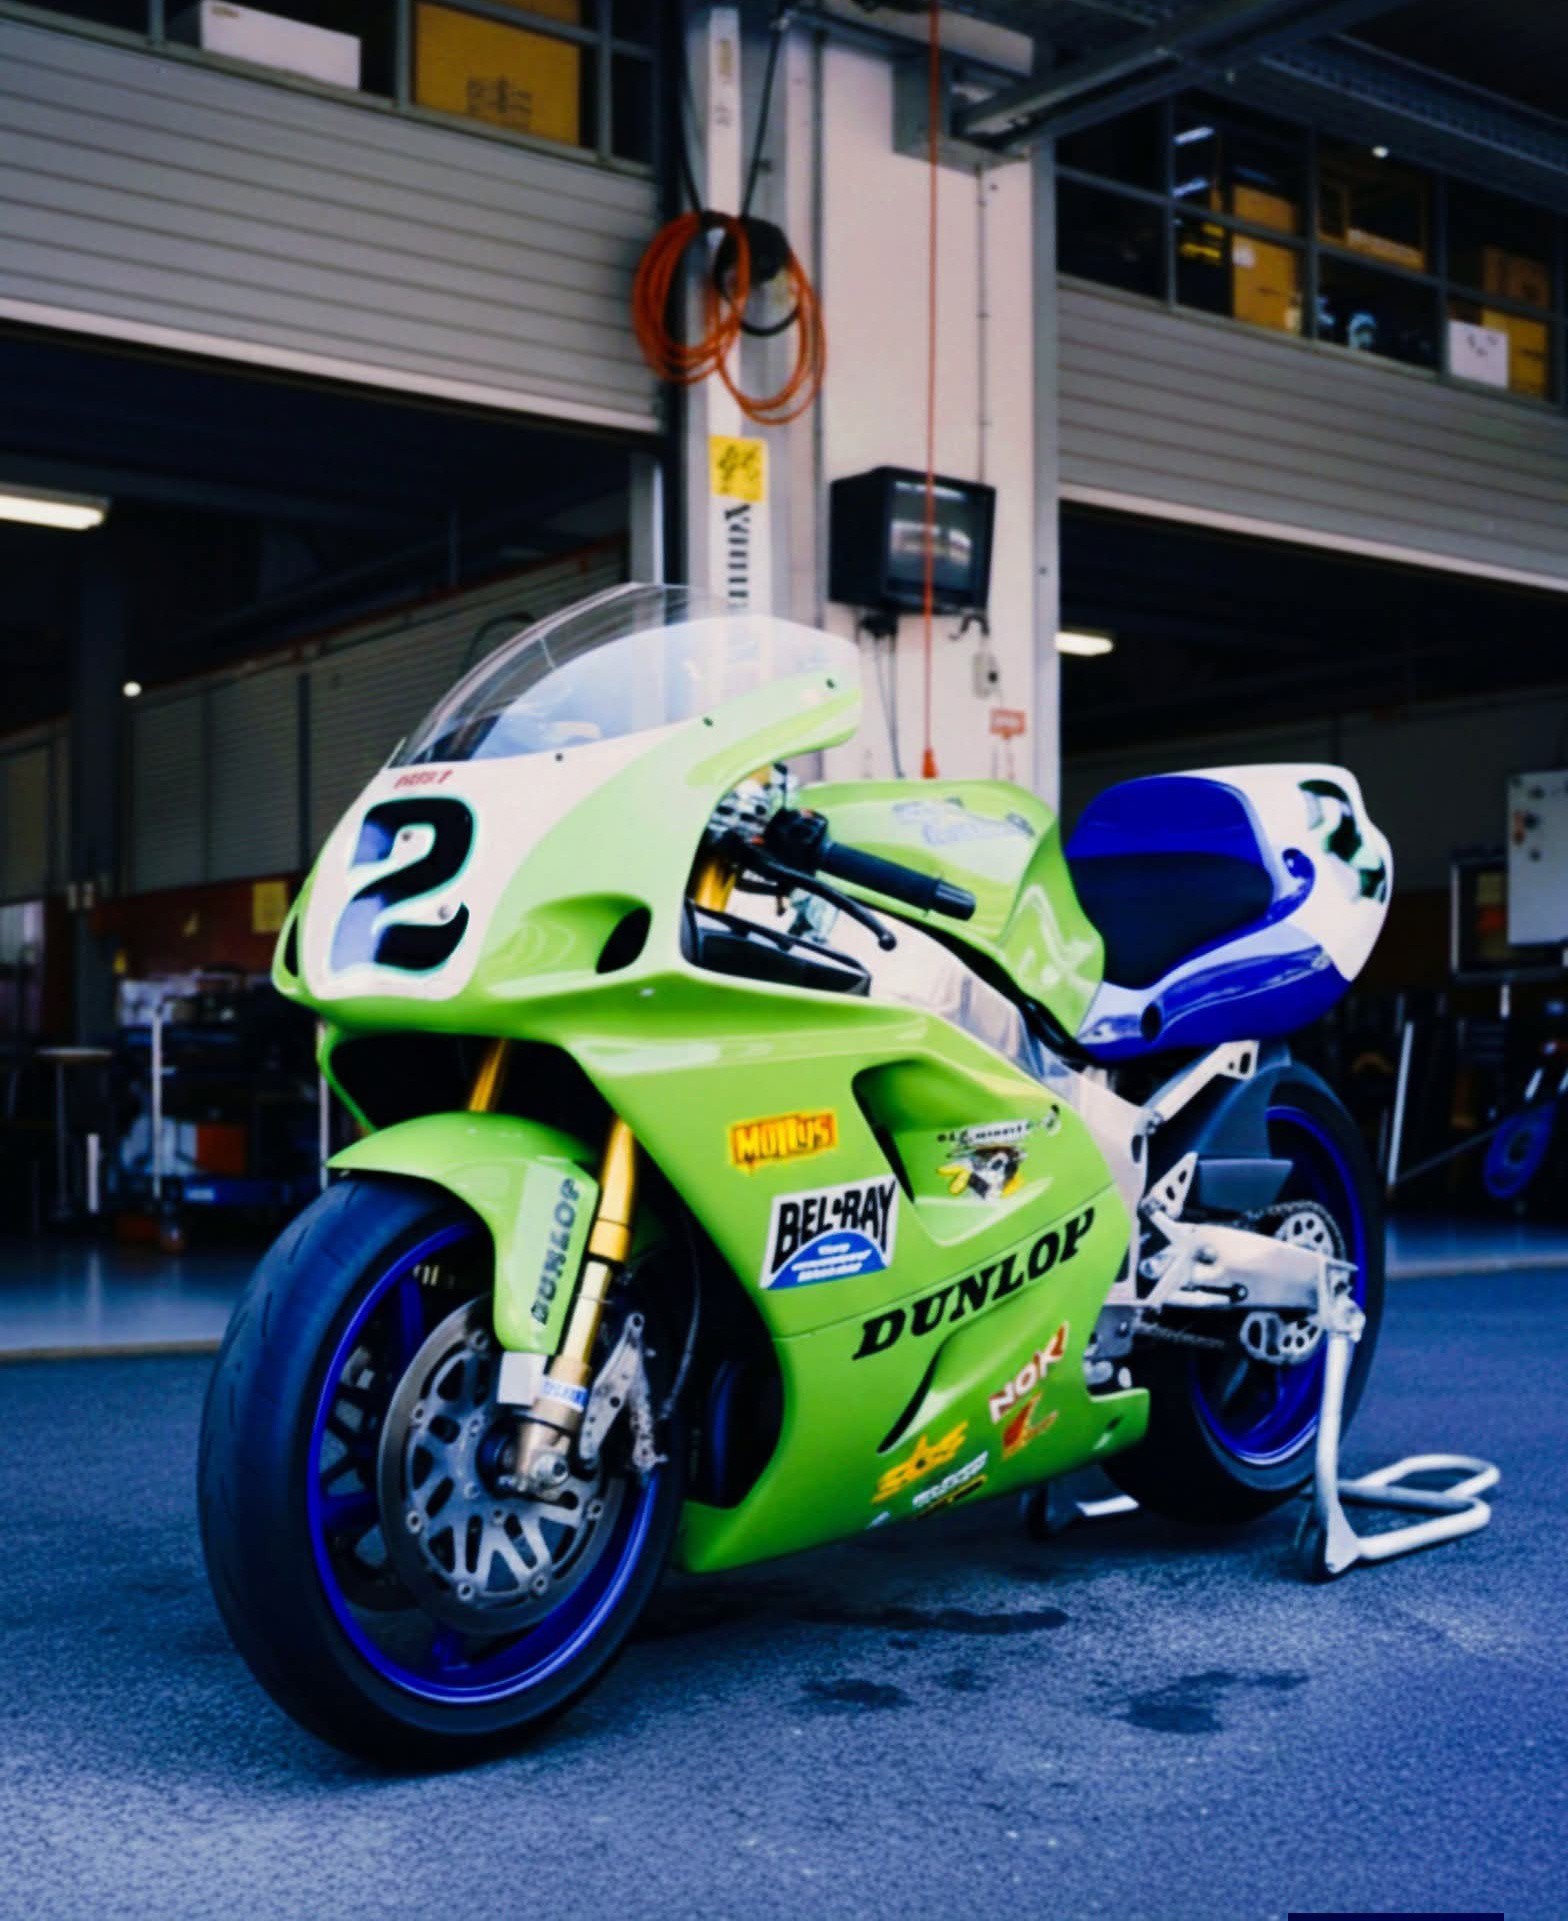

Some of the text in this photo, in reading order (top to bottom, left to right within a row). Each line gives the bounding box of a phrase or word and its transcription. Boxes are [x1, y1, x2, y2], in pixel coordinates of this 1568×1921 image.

[331, 797, 474, 974] 2
[530, 1178, 580, 1325] DUNLOP
[852, 1206, 1095, 1361] DUNLOP
[988, 1319, 1069, 1424] NOK
